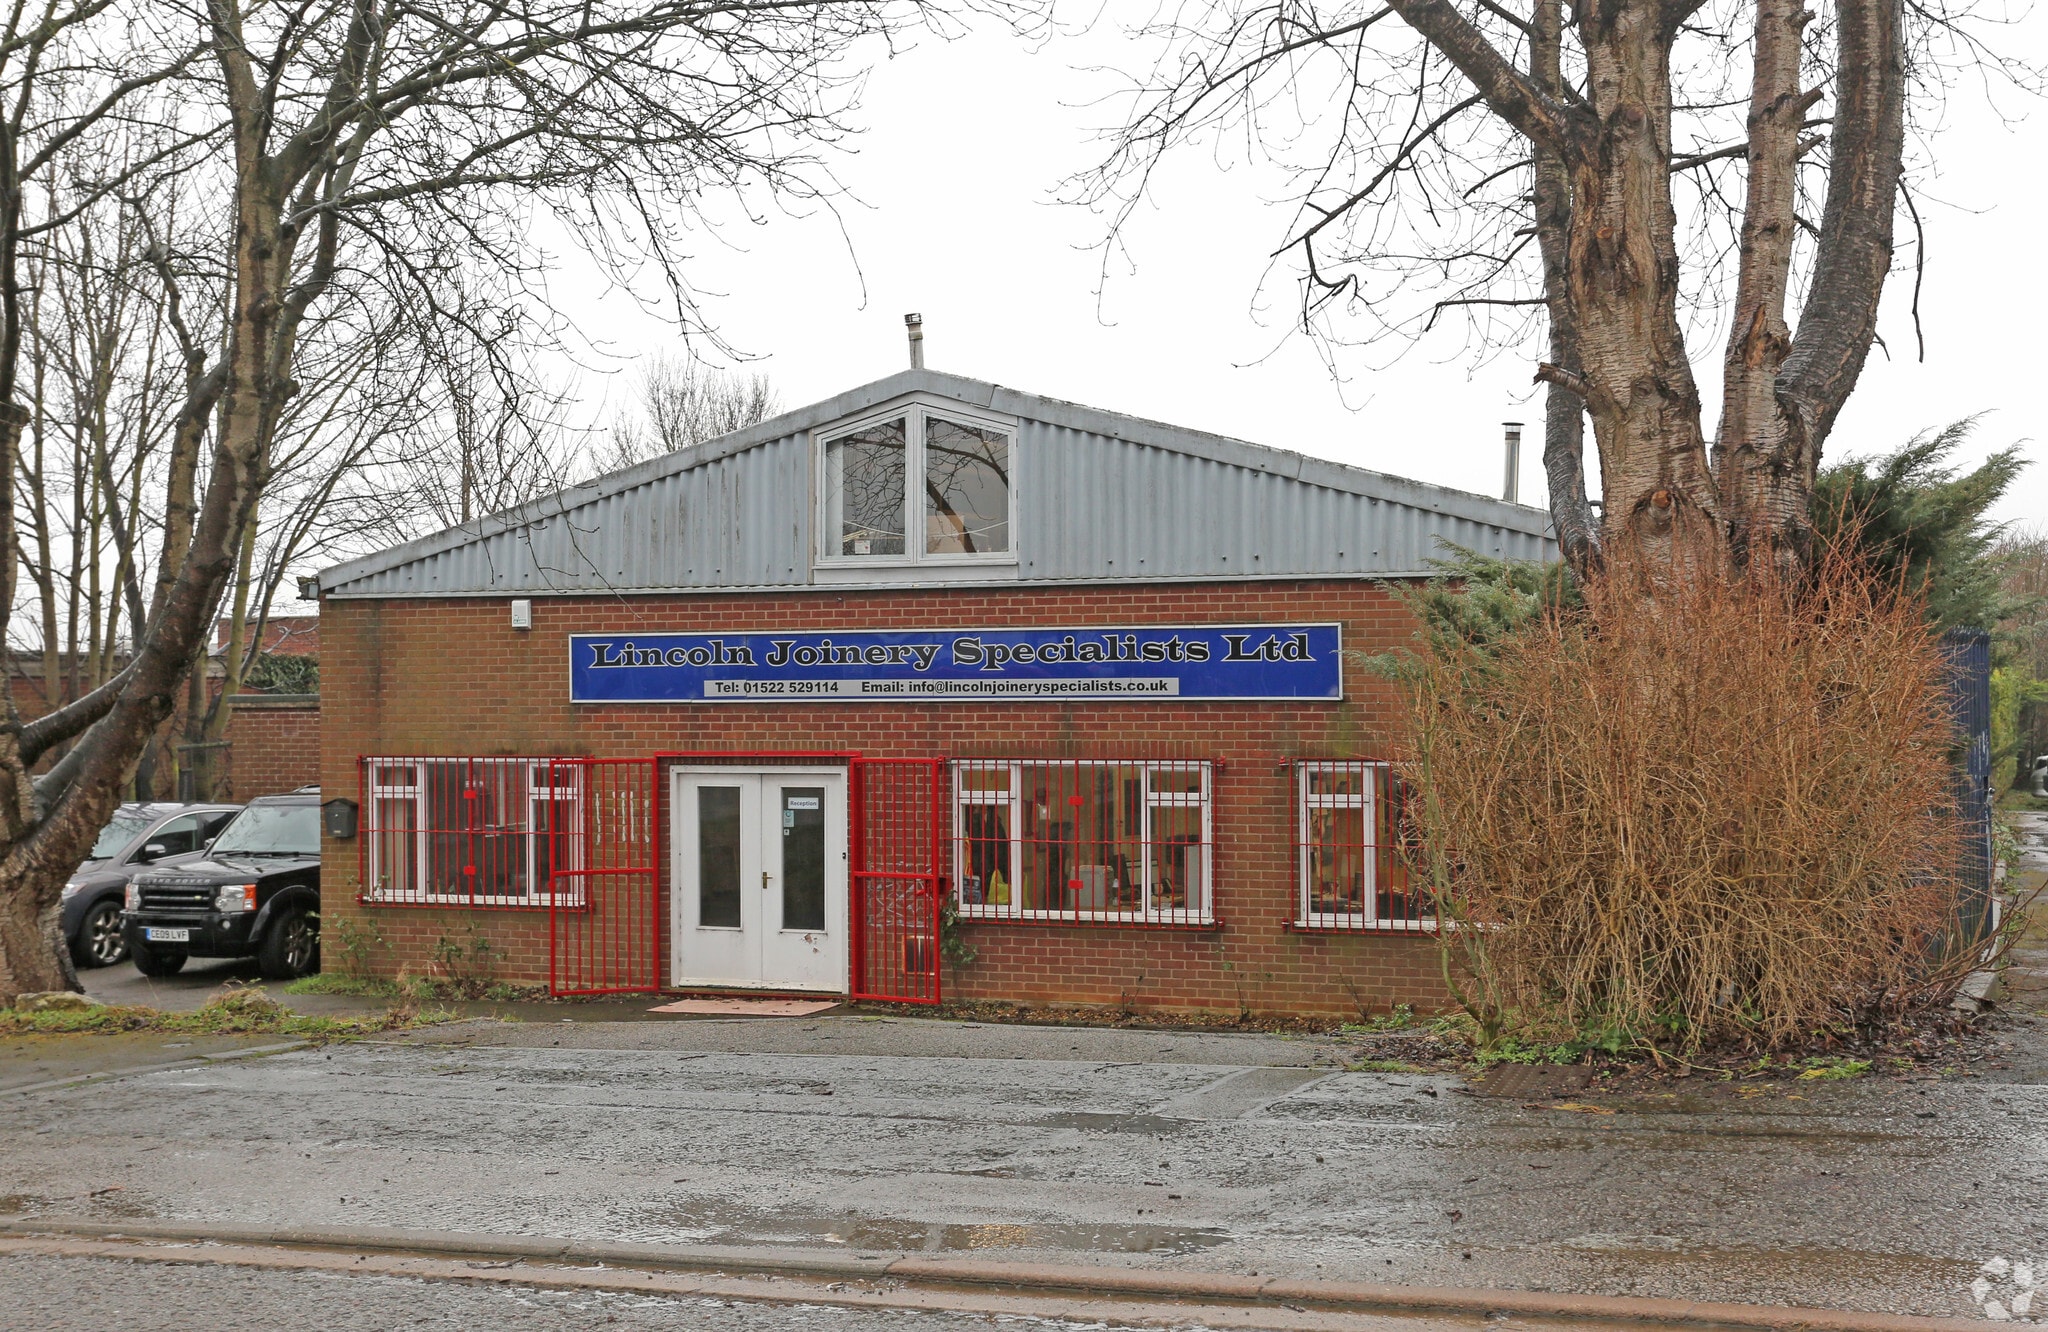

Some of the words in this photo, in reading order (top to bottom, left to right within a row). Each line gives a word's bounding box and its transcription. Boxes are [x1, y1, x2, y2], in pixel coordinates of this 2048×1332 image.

[588, 639, 758, 668] Lincoln
[765, 639, 943, 671] Joinery
[952, 634, 1210, 671] Specialists
[1221, 633, 1317, 662] Ltd
[715, 681, 739, 693] Tel:
[743, 681, 785, 693] 01522
[788, 681, 839, 693] 529114
[861, 681, 905, 693] Email:
[908, 680, 1168, 694] info@lincolnjoineryspecialists.co.uk
